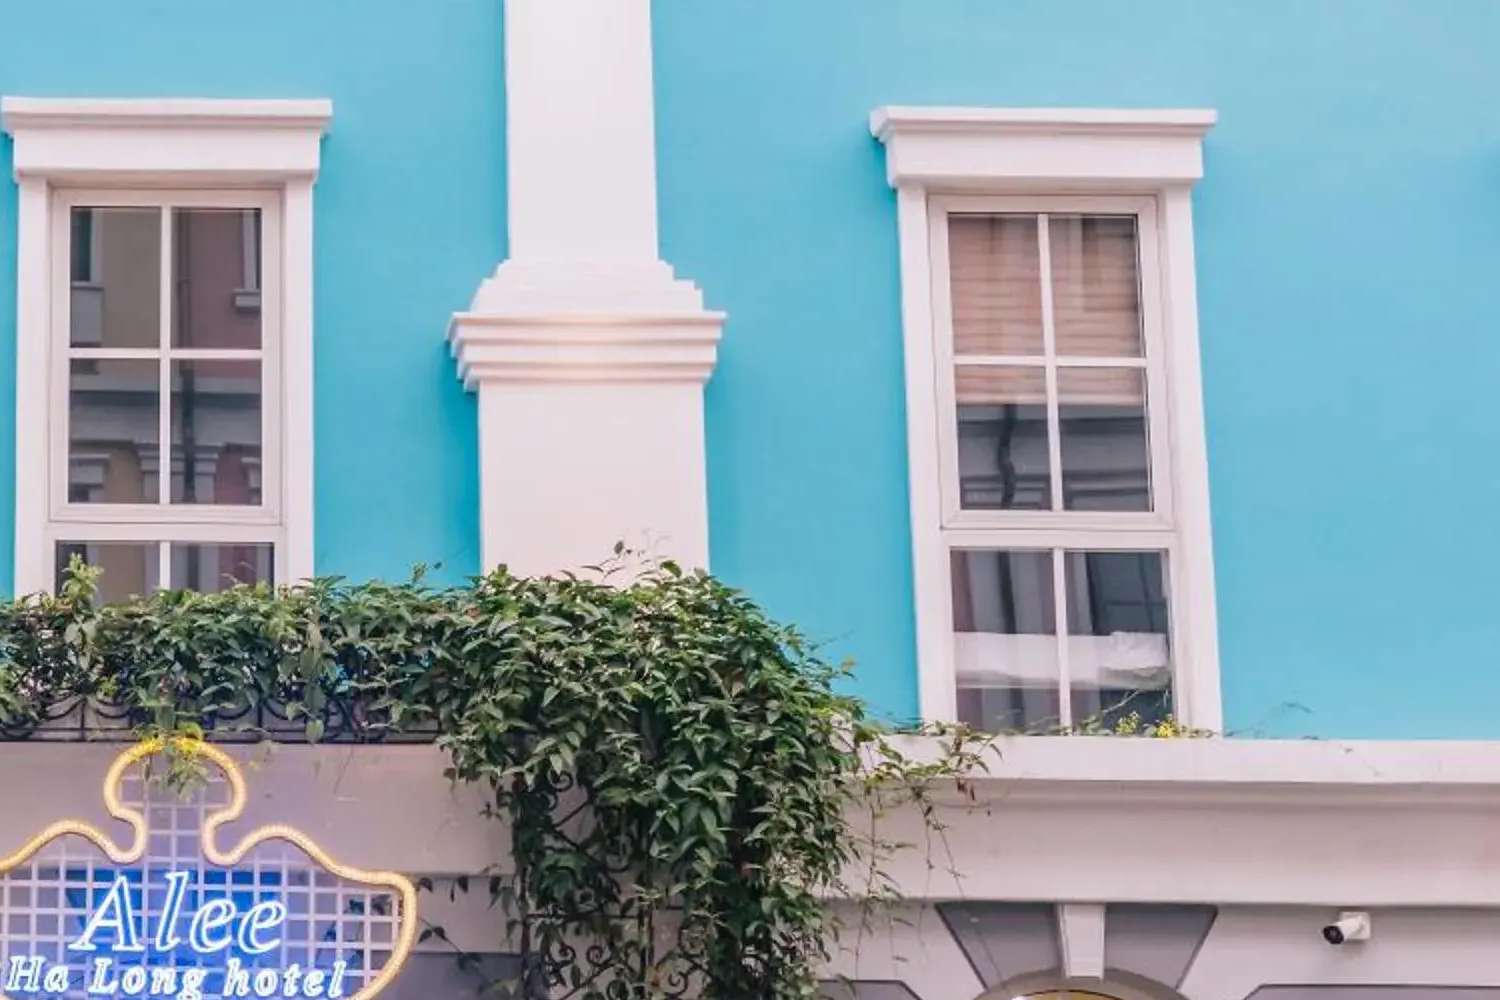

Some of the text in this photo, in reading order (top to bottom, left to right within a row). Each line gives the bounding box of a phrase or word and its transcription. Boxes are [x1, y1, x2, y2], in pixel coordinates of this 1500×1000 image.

[67, 870, 288, 954] Alee
[4, 954, 70, 994] Ha
[222, 957, 348, 1000] hotel
